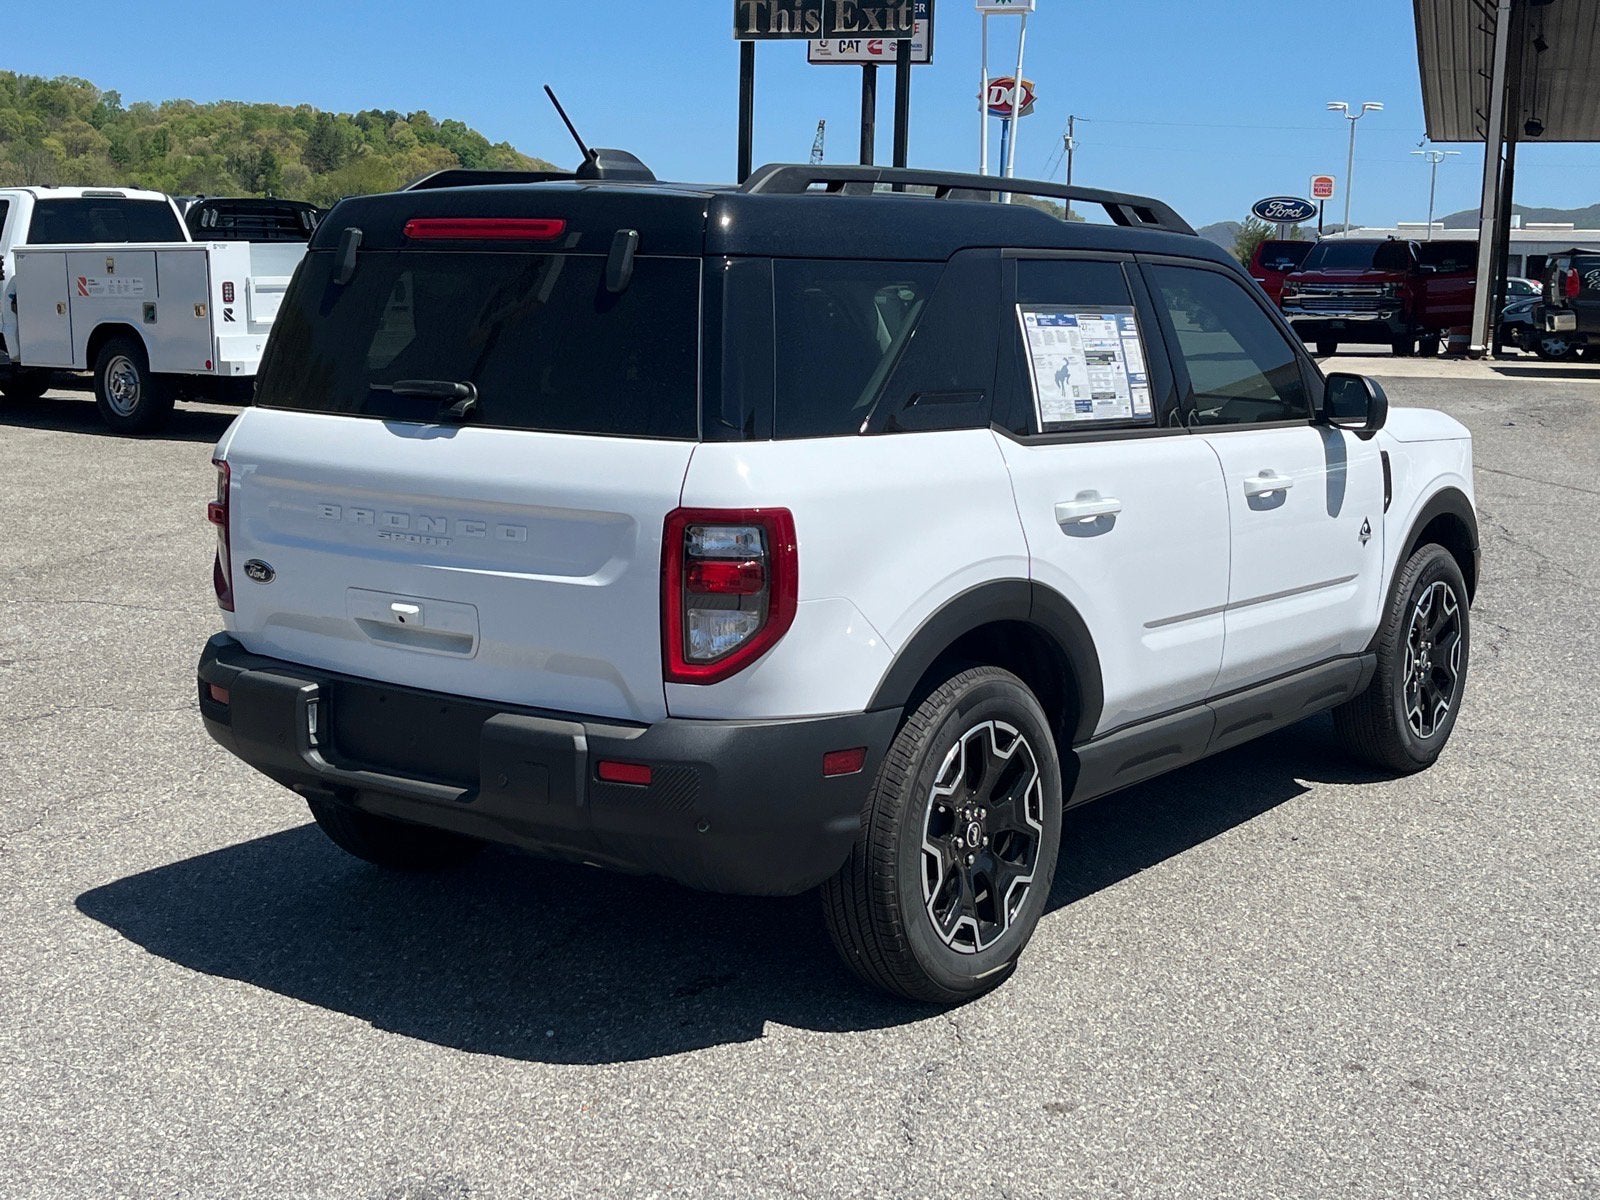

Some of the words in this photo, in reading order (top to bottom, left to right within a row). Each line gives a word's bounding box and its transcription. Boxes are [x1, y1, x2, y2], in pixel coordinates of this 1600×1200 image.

[740, 0, 820, 33] This
[832, 0, 912, 33] Exit
[838, 40, 862, 54] CAT
[988, 85, 1023, 108] DQ
[1265, 201, 1304, 217] Ford
[316, 503, 528, 543] BRONCO
[377, 530, 454, 546] SPORT
[248, 563, 266, 579] Ford
